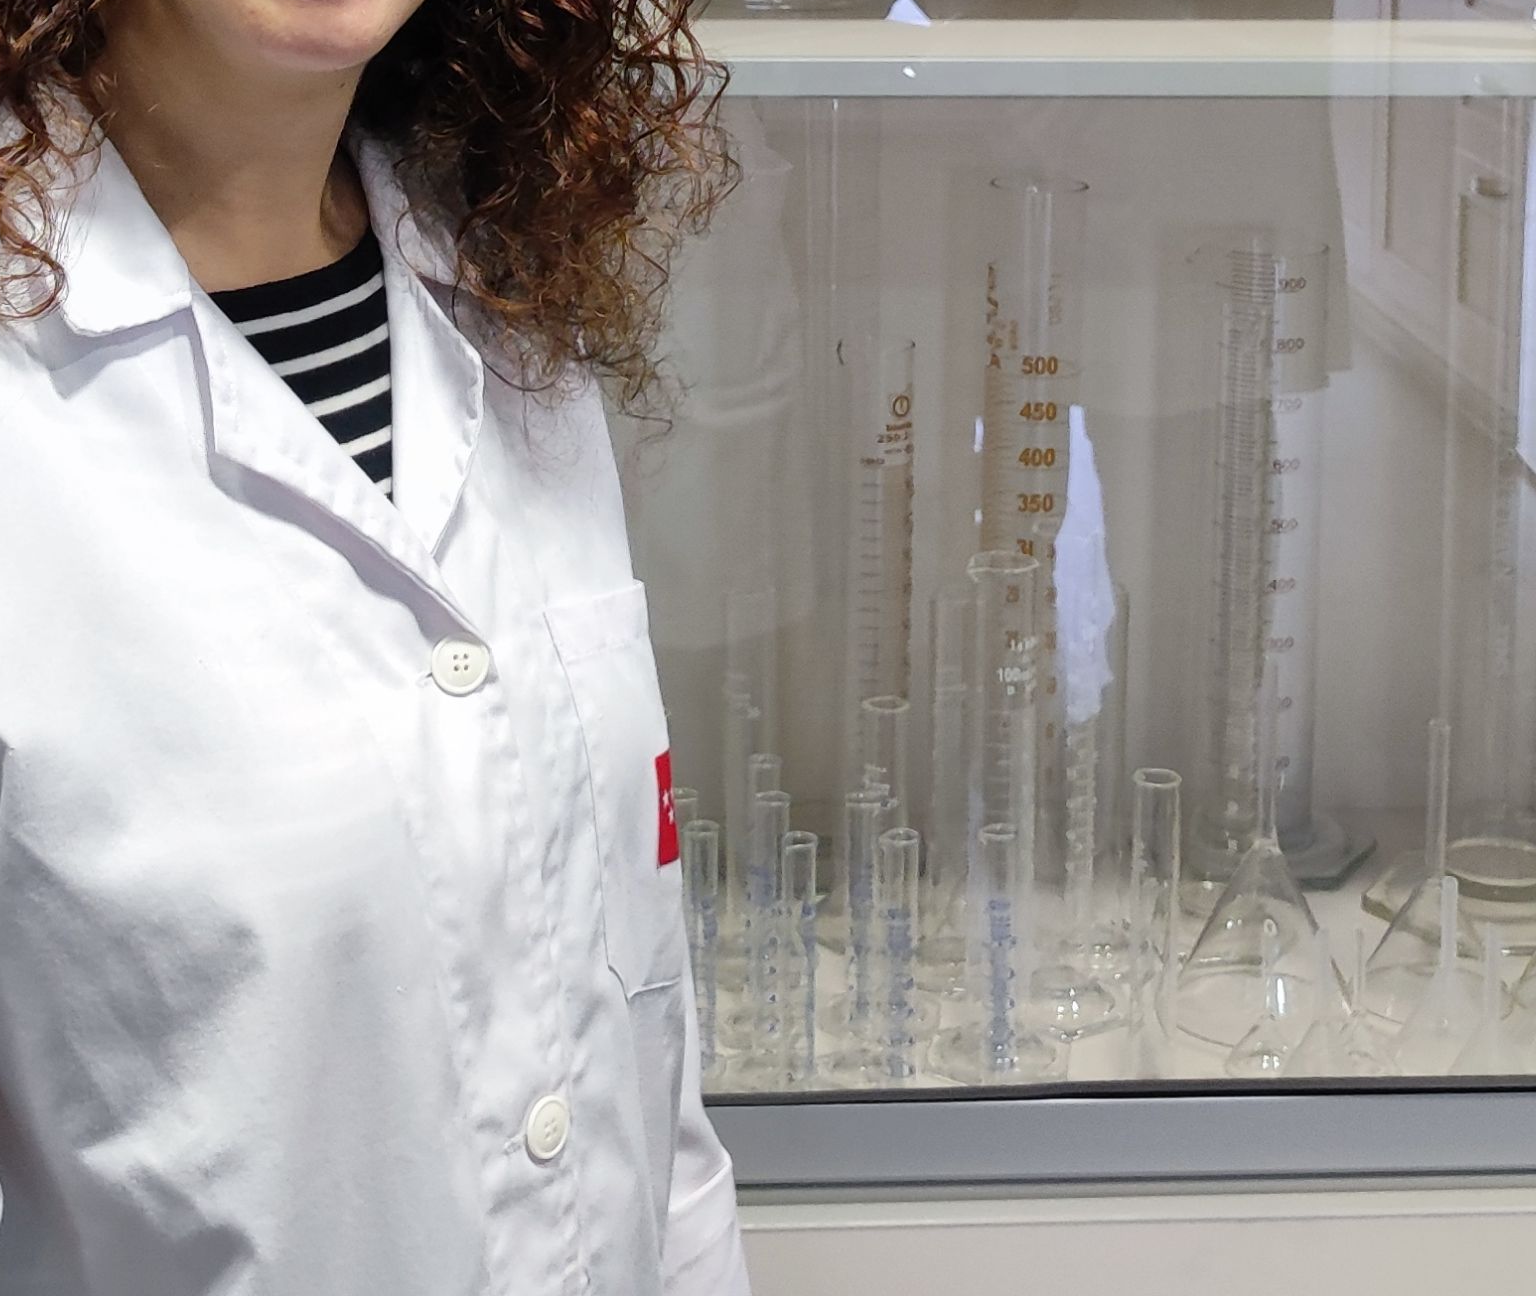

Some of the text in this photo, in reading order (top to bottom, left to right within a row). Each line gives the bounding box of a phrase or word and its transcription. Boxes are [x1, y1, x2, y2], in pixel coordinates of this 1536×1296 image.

[1277, 338, 1304, 350] 800
[1022, 356, 1058, 374] 500
[1019, 403, 1057, 420] 450
[1018, 448, 1056, 466] 400
[1017, 493, 1054, 512] 350
